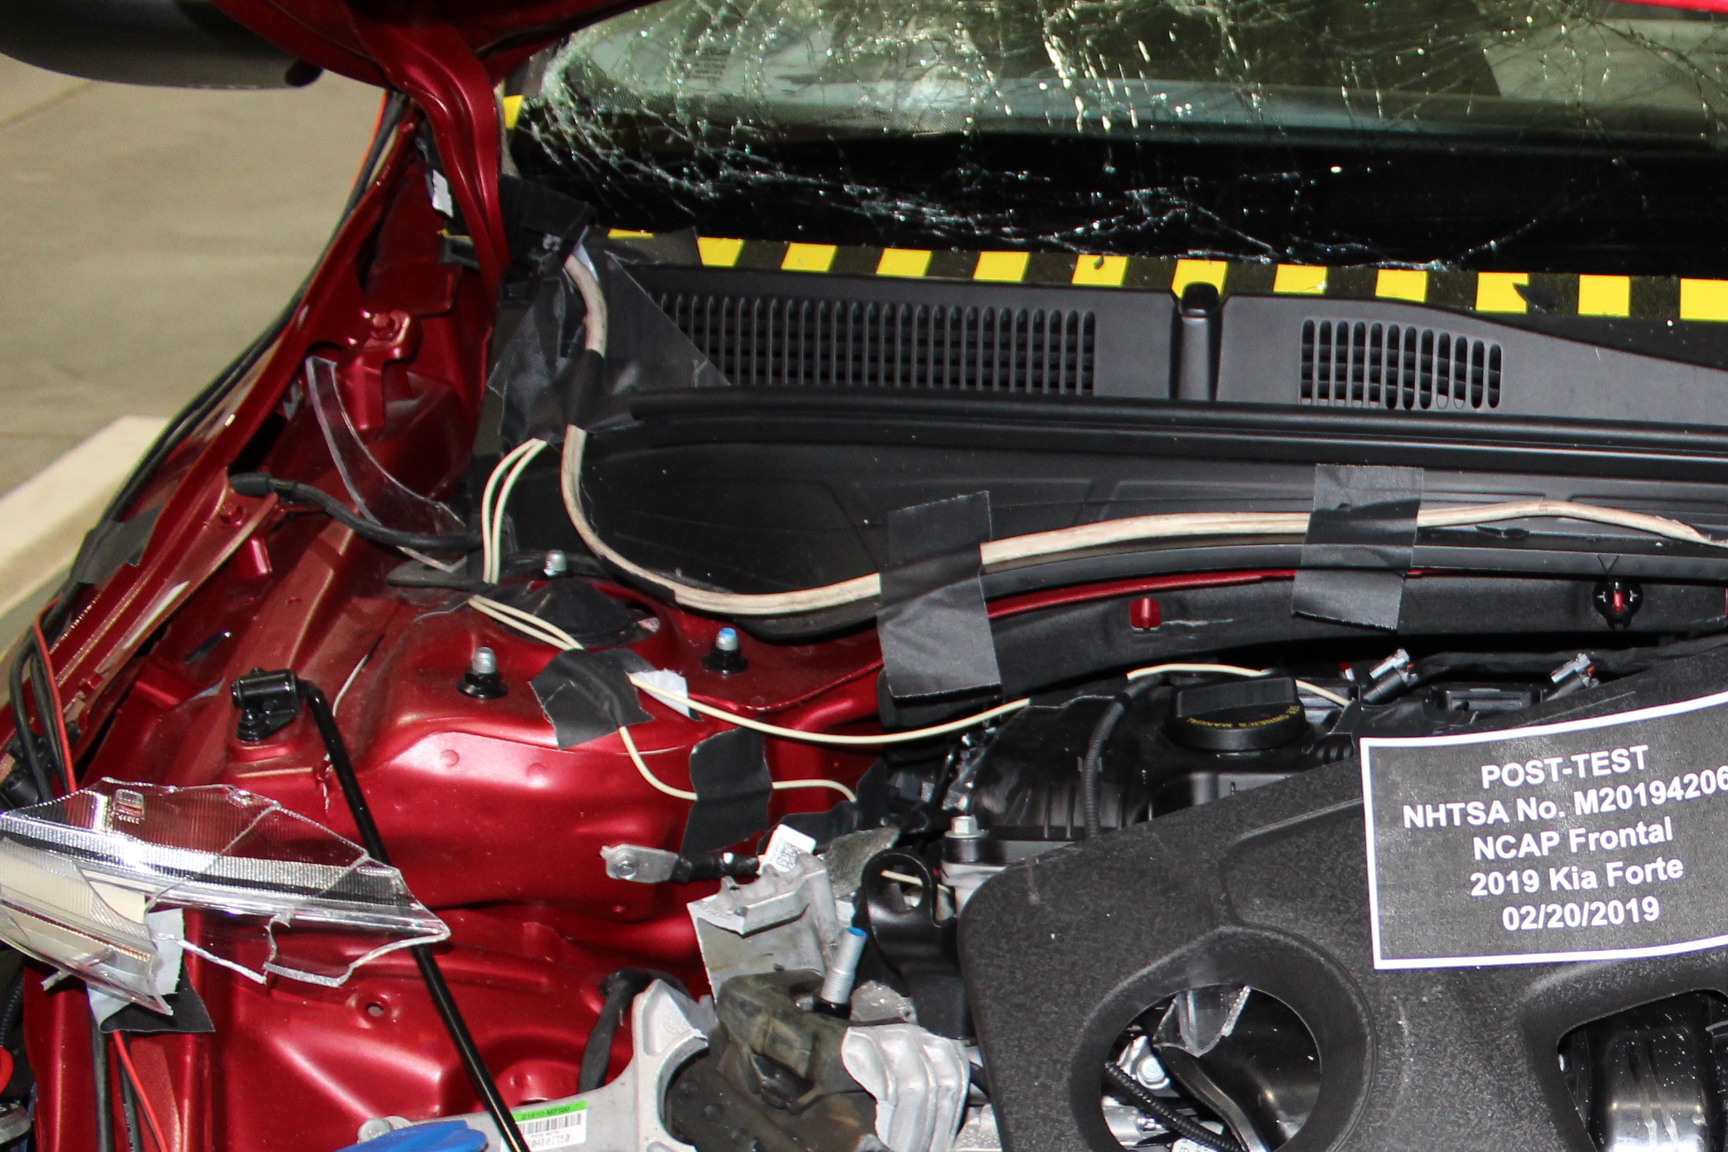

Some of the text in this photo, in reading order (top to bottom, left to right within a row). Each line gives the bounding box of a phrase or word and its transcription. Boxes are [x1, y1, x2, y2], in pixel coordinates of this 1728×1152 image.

[1186, 716, 1234, 728] MANUAL
[1238, 713, 1290, 728] OWNER'S
[1481, 745, 1650, 788] POST-TEST
[1403, 800, 1509, 828] NHTSA
[1516, 797, 1566, 822] No.
[1473, 816, 1674, 861] NCAP Frontal
[1470, 856, 1685, 897] 2019 Kia Forte
[1502, 896, 1660, 931] 02/20/2019
